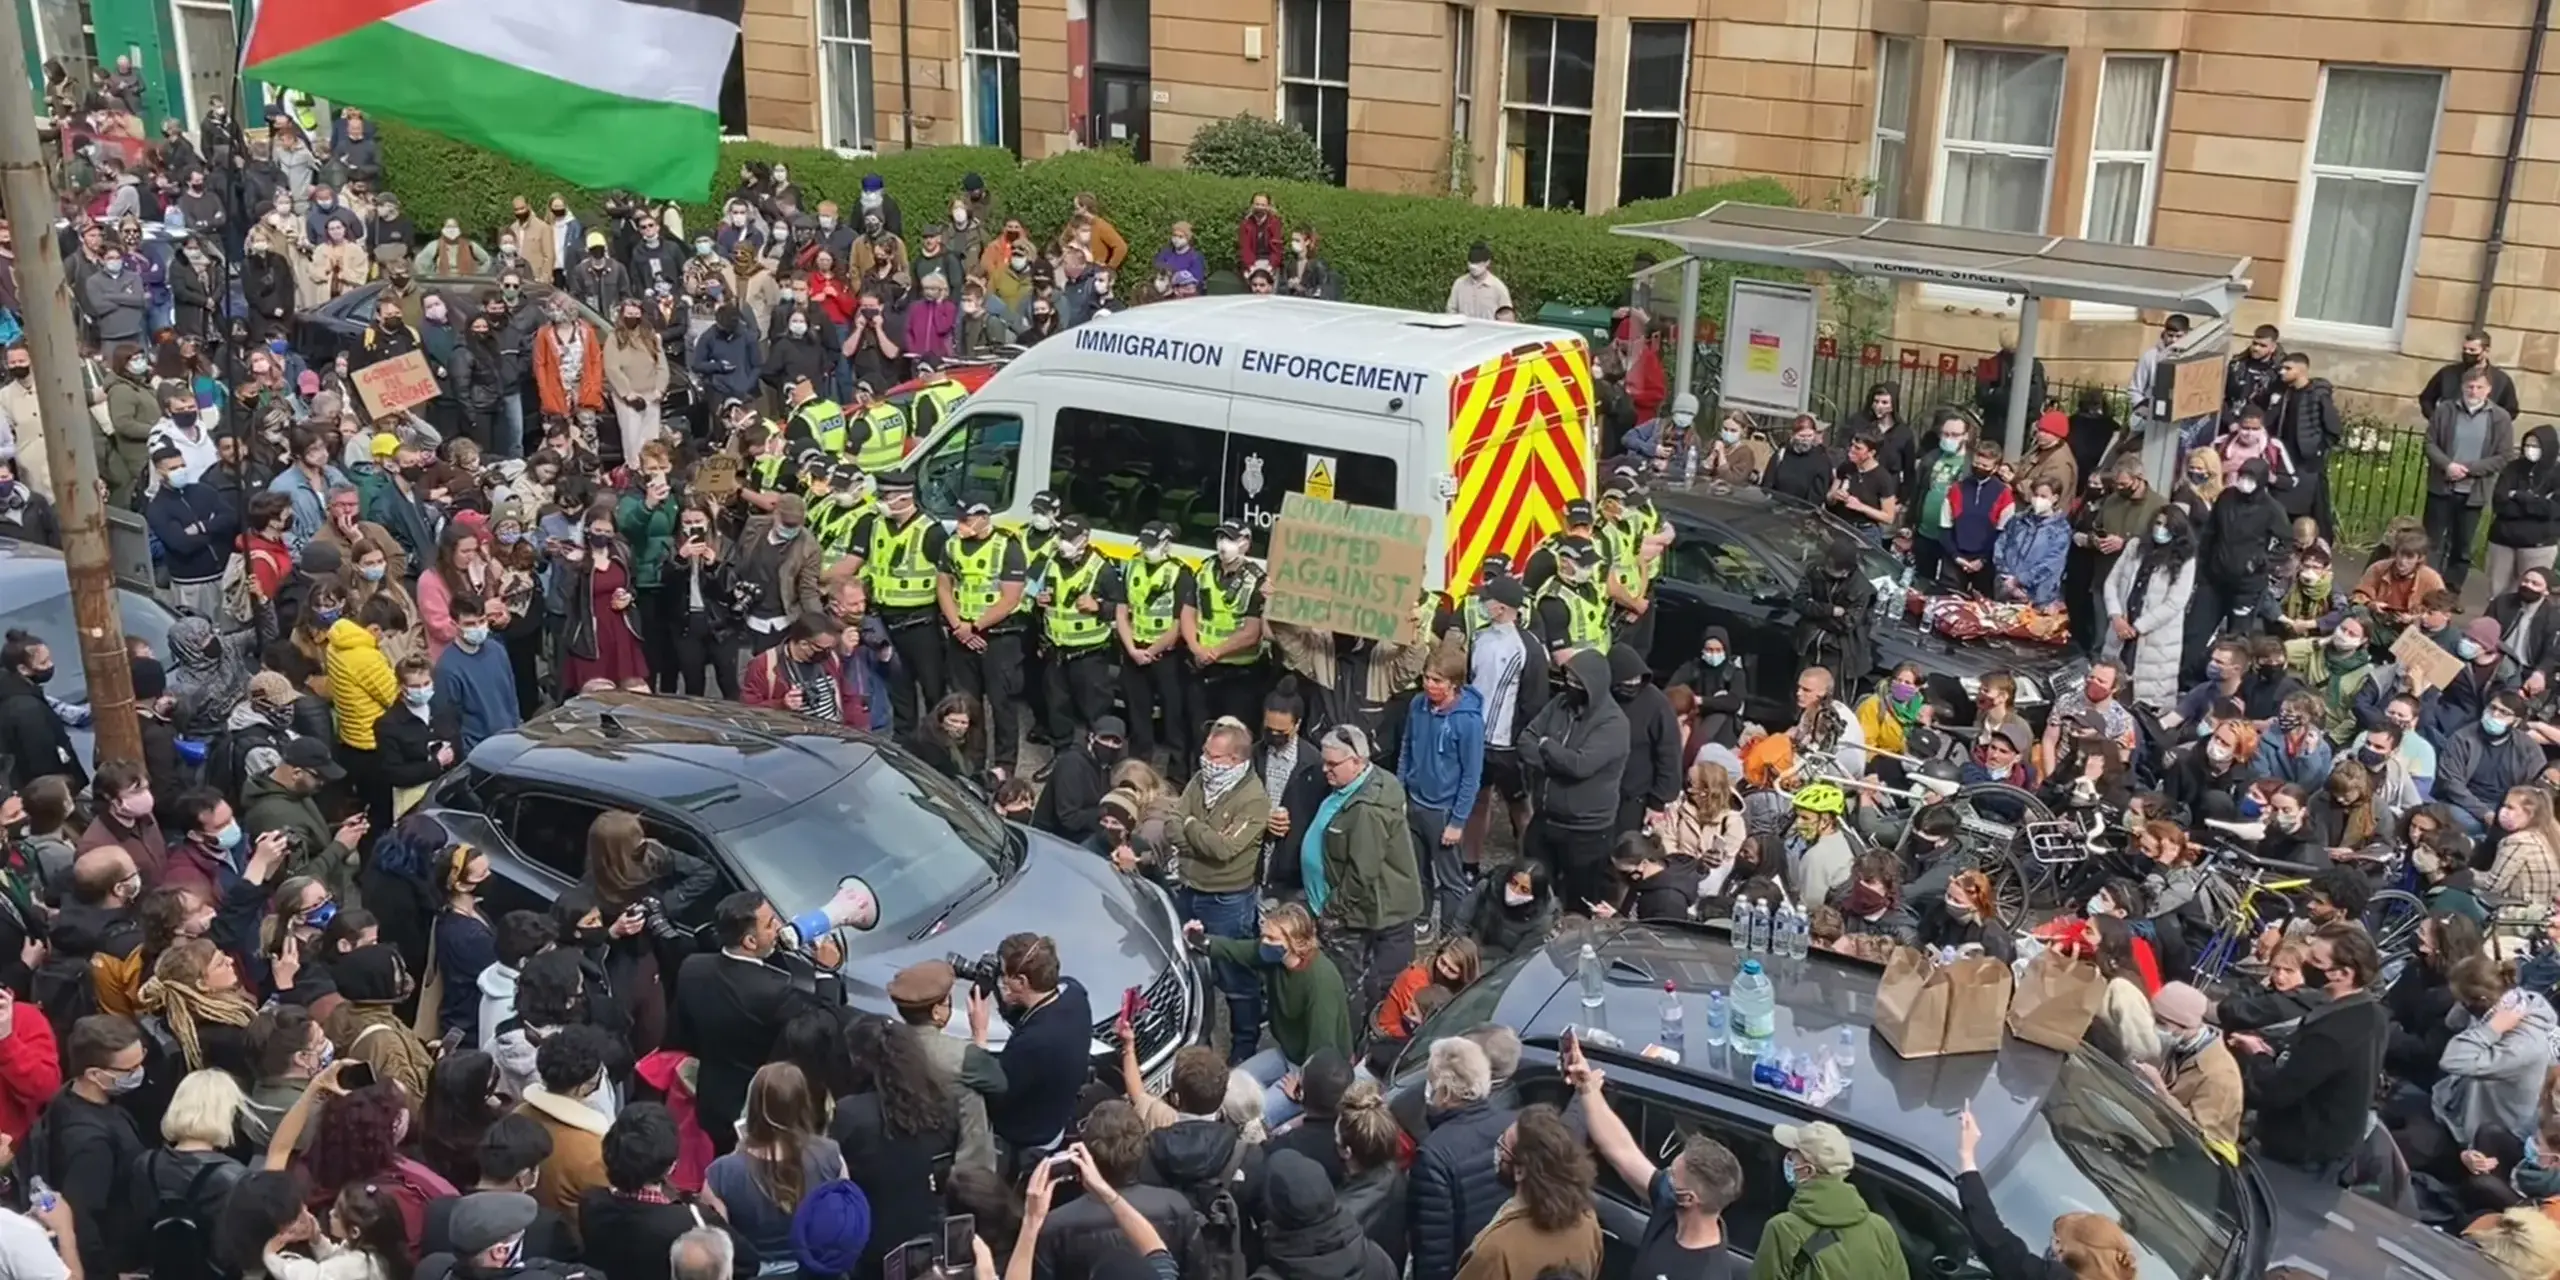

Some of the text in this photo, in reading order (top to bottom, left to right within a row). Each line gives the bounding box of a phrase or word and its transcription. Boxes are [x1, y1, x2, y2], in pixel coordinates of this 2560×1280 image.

[1075, 329, 1429, 396] IMMIGRATION ENFORCEMENT
[1285, 527, 1381, 567] UNITED
[1275, 557, 1412, 608] AGAINST
